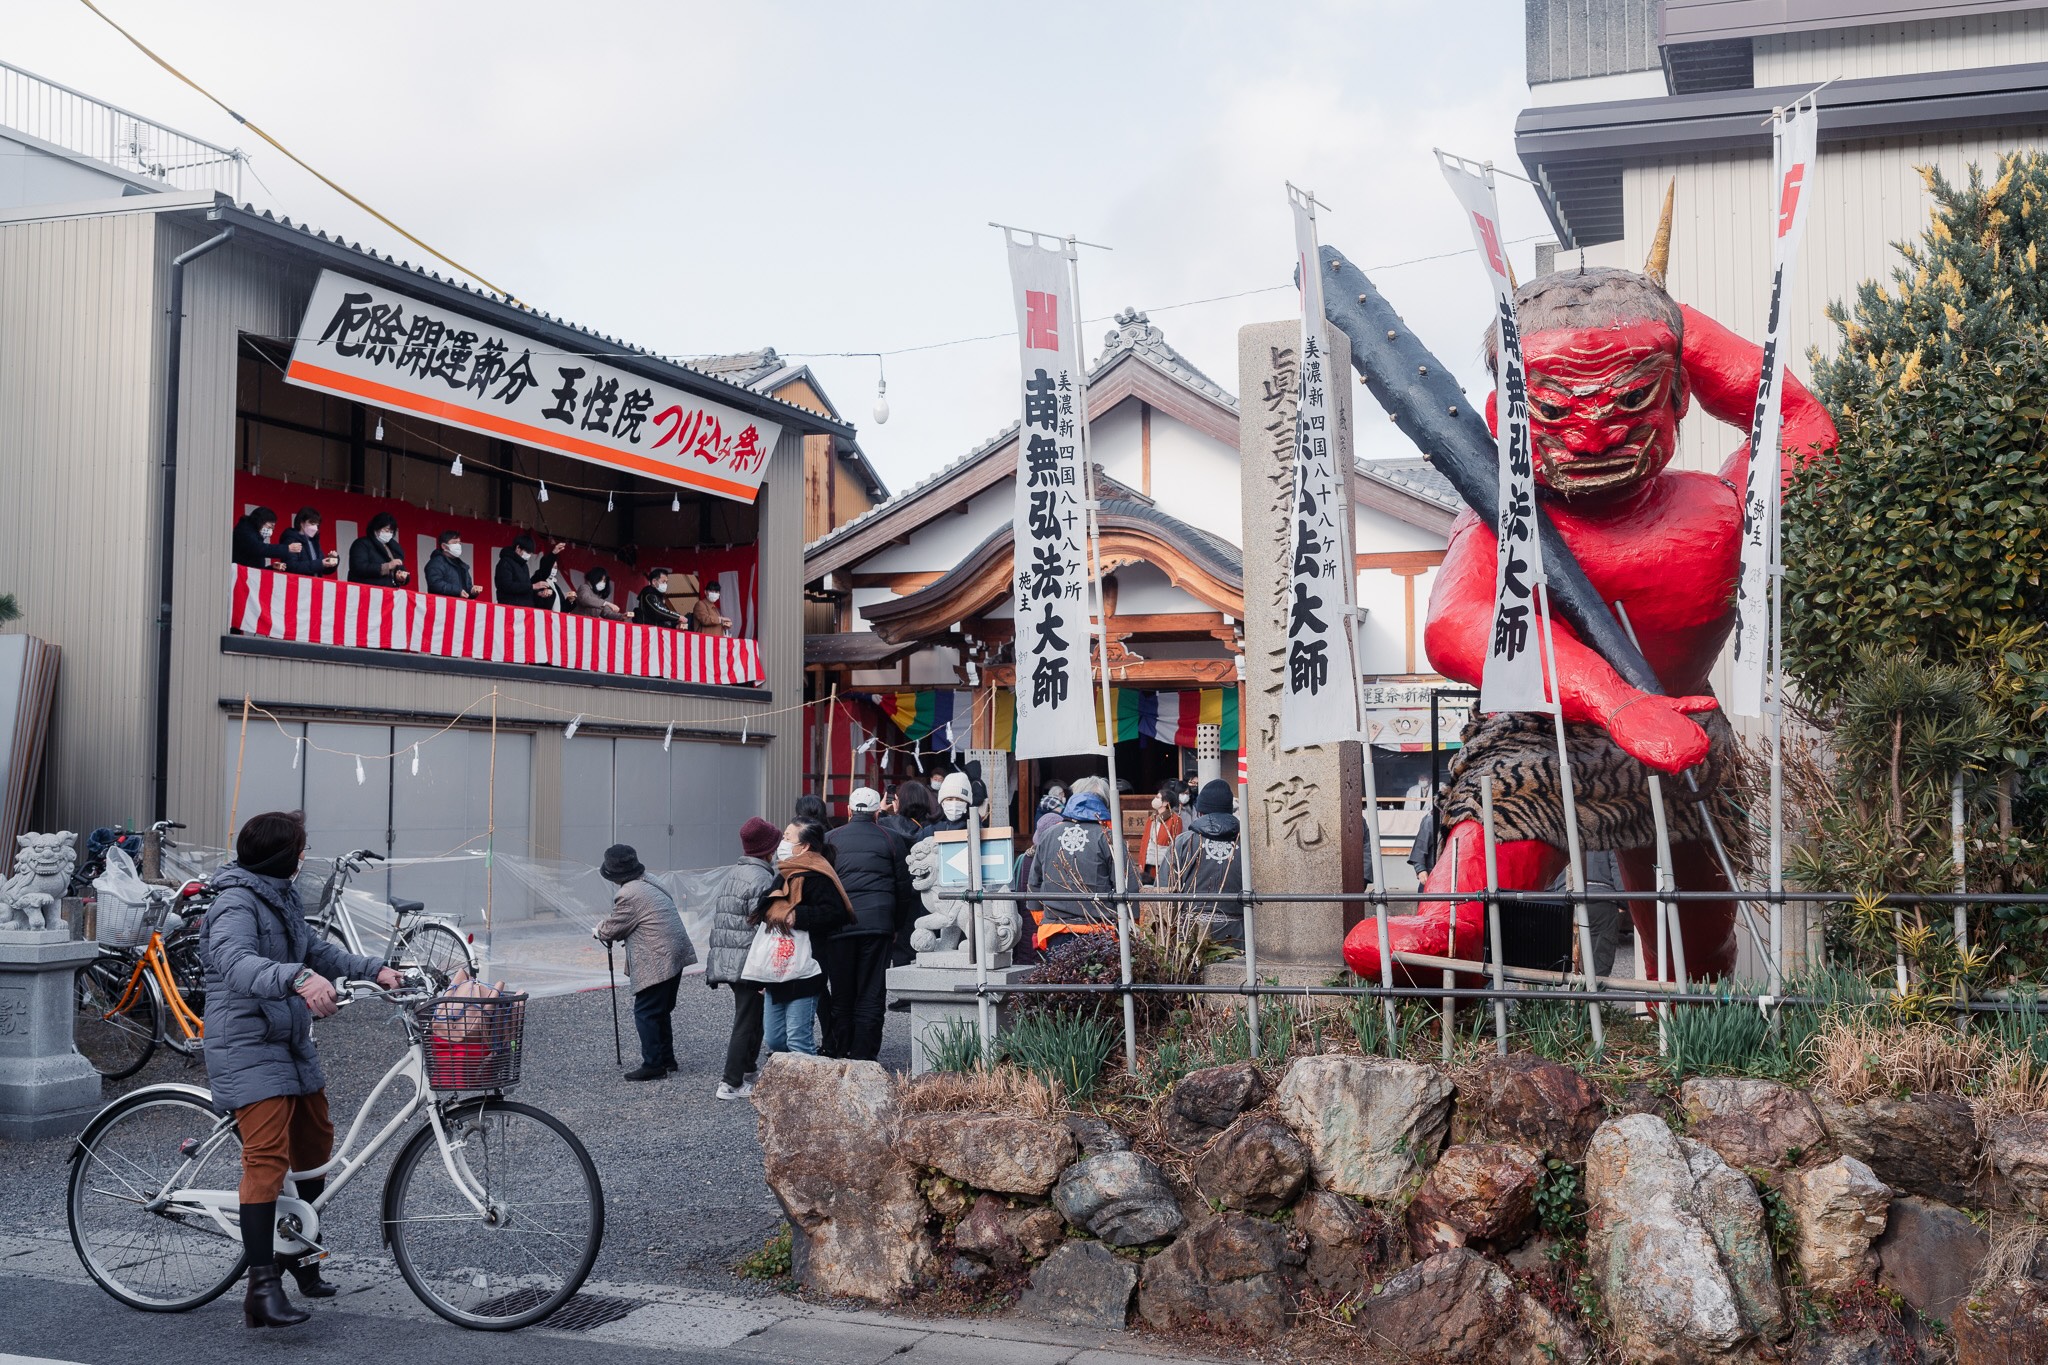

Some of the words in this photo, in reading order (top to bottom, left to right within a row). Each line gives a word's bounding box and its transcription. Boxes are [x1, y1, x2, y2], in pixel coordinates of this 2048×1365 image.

[317, 292, 539, 404] 厄除開運節分
[541, 367, 654, 445] 玉性院
[1018, 572, 1032, 612] 施主
[1026, 368, 1069, 710] 南無弘法大師
